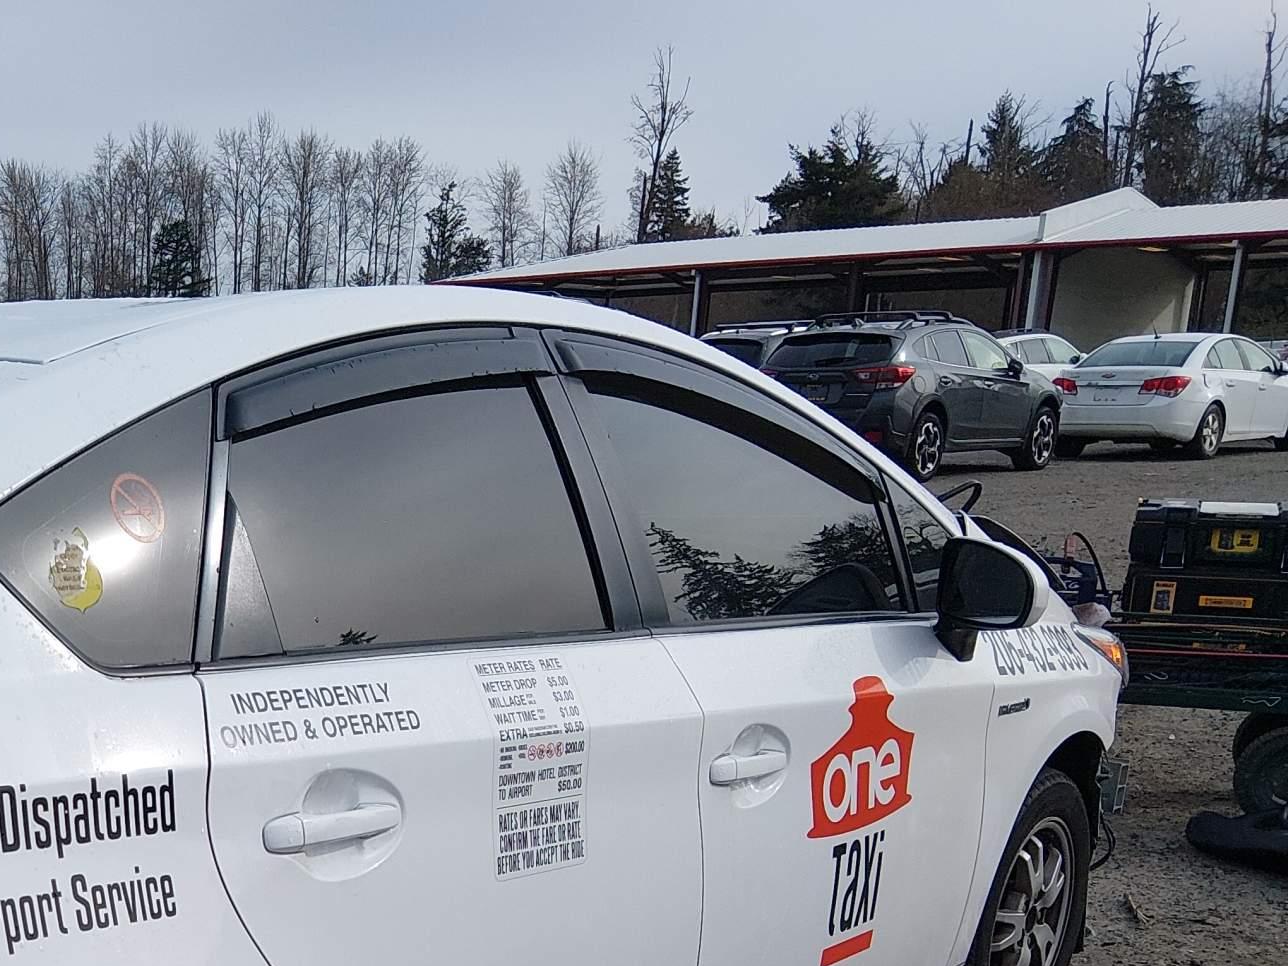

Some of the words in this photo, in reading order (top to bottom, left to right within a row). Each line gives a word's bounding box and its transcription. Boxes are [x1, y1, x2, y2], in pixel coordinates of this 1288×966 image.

[474, 662, 507, 675] METER
[508, 660, 536, 673] RATES
[539, 658, 562, 671] RATE
[482, 680, 514, 693] METER
[514, 678, 537, 690] DROP
[546, 675, 569, 688] $5.00
[231, 682, 391, 715] INDEPENDENTLY
[488, 694, 527, 708] MILLAGE
[553, 689, 575, 702] $3.00
[494, 711, 516, 725] WAIT
[516, 709, 538, 722] TIME
[559, 705, 580, 718] $1.00
[220, 720, 298, 749] OWNED
[304, 719, 319, 740] &
[322, 710, 421, 738] OPERATED
[499, 728, 528, 742] EXTRA
[563, 721, 585, 734] $0.50
[499, 770, 536, 787] DOWNTOWN
[537, 767, 556, 782] HOTEL
[558, 763, 582, 778] DISTRICT
[822, 738, 902, 823] one
[498, 788, 506, 800] TO
[508, 785, 533, 799] AIRPORT
[558, 777, 582, 792] $50.00
[499, 811, 518, 833] RATES
[519, 810, 528, 829] OR
[529, 807, 548, 827] FARES
[549, 804, 563, 823] MAY
[499, 831, 529, 854] CONFIRM
[529, 828, 540, 847] THE
[542, 825, 556, 845] FARE
[558, 823, 566, 842] OR
[567, 821, 581, 840] RATE
[497, 853, 520, 875] BEFORE
[522, 850, 535, 870] YOU
[535, 845, 558, 867] ACCEPT
[560, 842, 570, 862] THE
[571, 840, 584, 859] RIDE
[71, 866, 177, 933] Service
